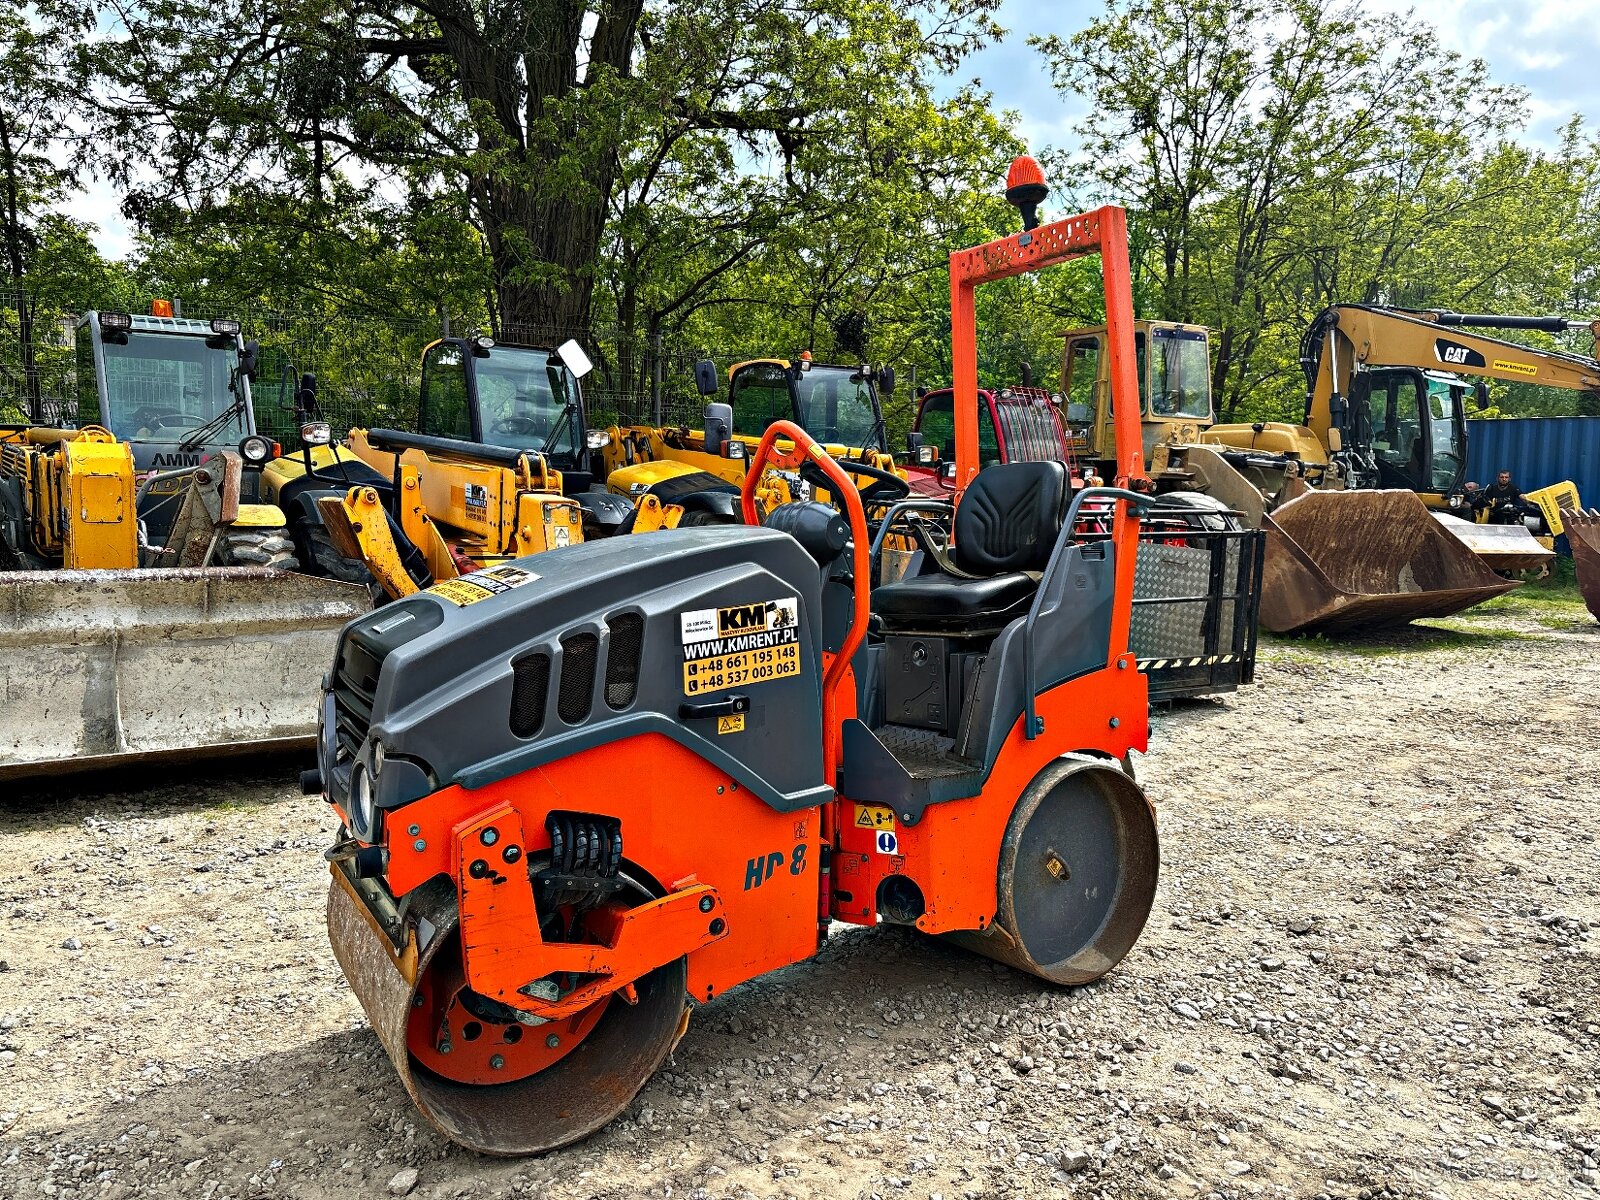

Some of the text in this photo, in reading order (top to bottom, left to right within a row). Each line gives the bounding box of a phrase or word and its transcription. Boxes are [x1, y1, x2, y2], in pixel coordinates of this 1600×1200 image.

[1444, 346, 1470, 364] CAT
[719, 604, 765, 631] KM
[684, 631, 798, 660] WWW.KMRENT.PL
[700, 646, 796, 674] +48 661 195 148
[700, 660, 796, 689] +48 537 003 063
